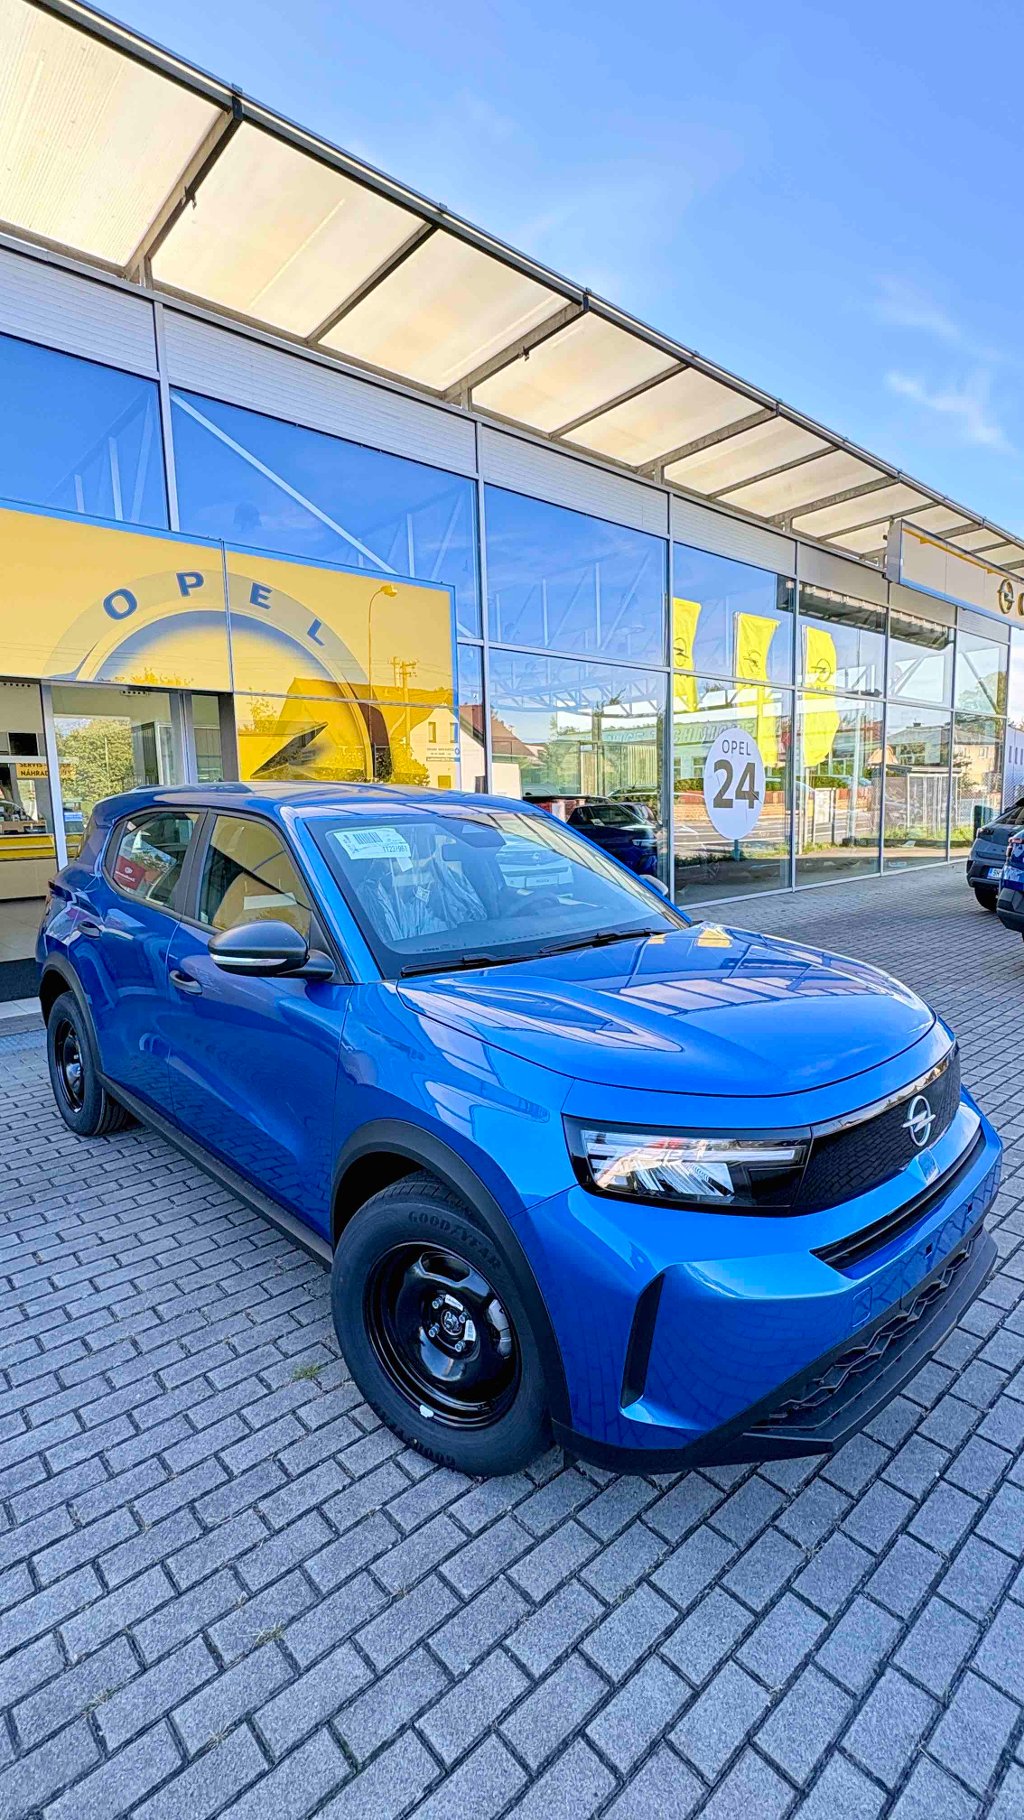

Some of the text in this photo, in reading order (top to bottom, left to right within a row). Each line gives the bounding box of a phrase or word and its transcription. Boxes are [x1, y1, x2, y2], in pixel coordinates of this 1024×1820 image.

[102, 571, 325, 646] OPEL
[722, 739, 751, 756] OPEL
[713, 759, 759, 809] 24
[408, 1211, 502, 1270] GOODYEAR
